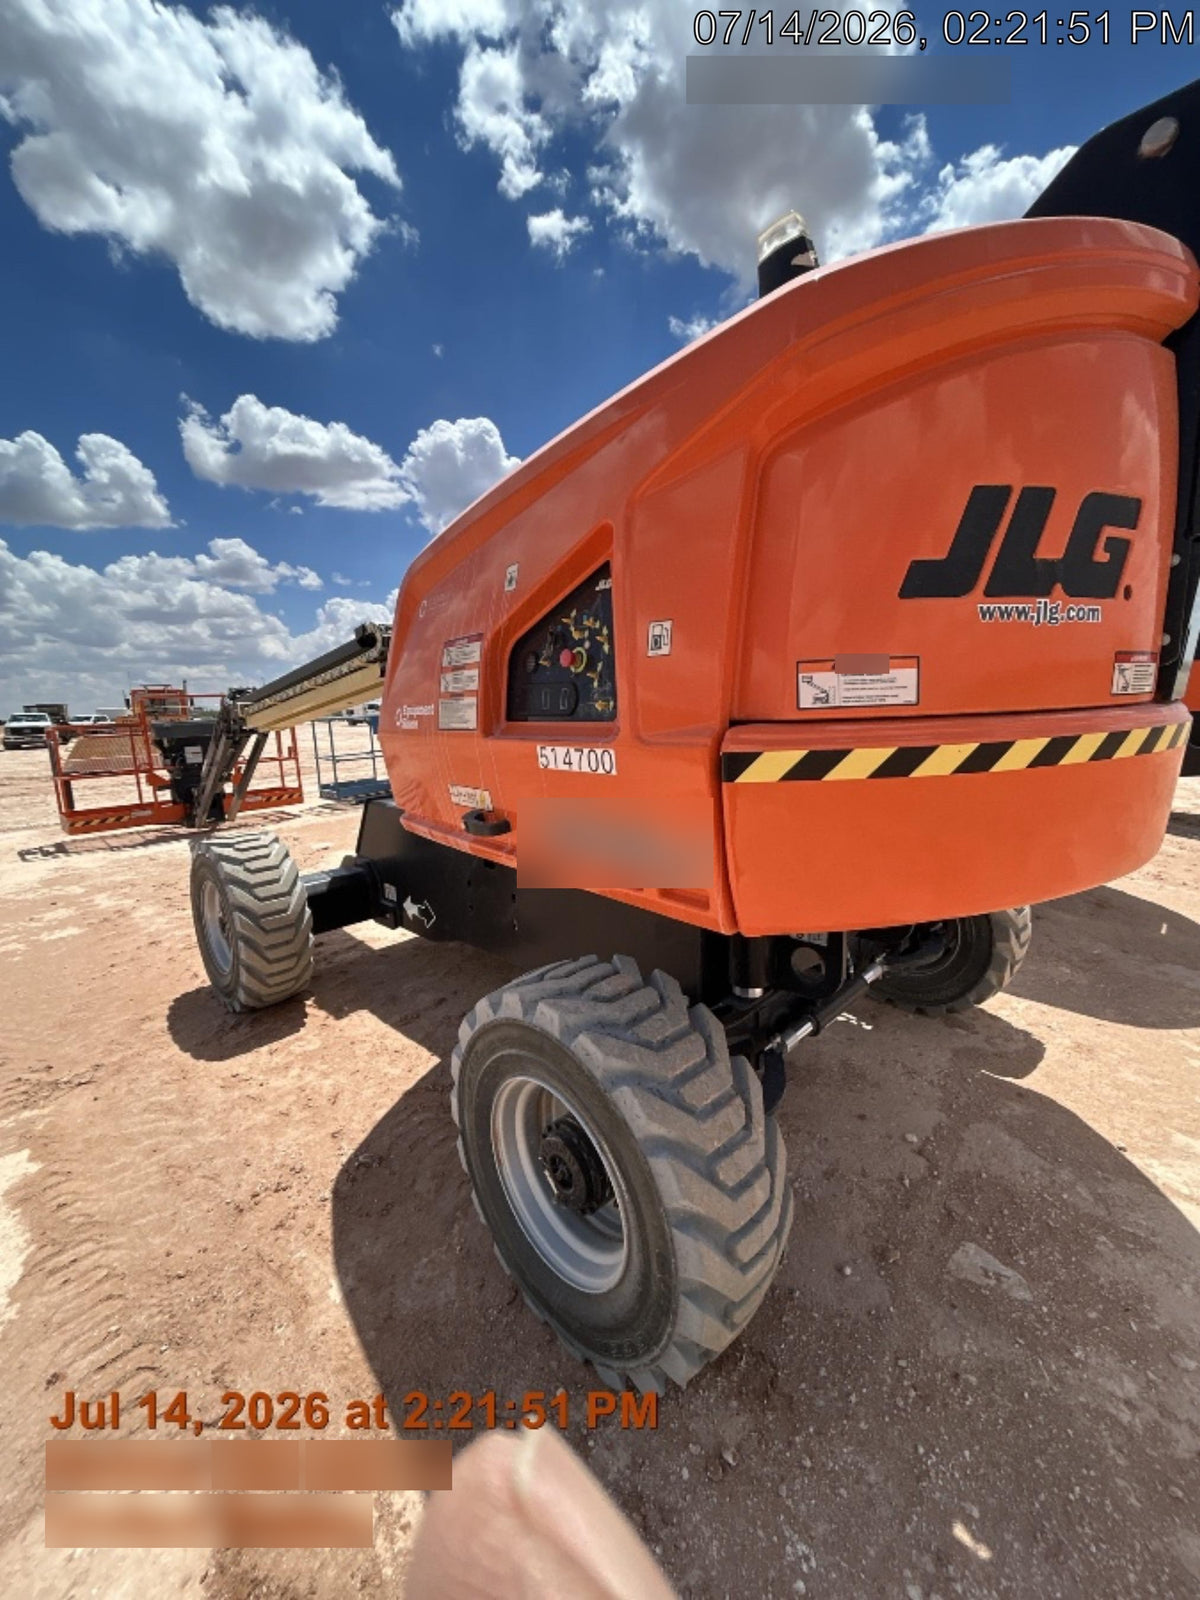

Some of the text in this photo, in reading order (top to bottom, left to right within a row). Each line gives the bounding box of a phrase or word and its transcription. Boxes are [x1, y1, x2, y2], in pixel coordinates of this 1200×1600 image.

[898, 484, 1142, 600] JLG
[977, 599, 1101, 626] www.jlg.com
[539, 746, 614, 775] 514700
